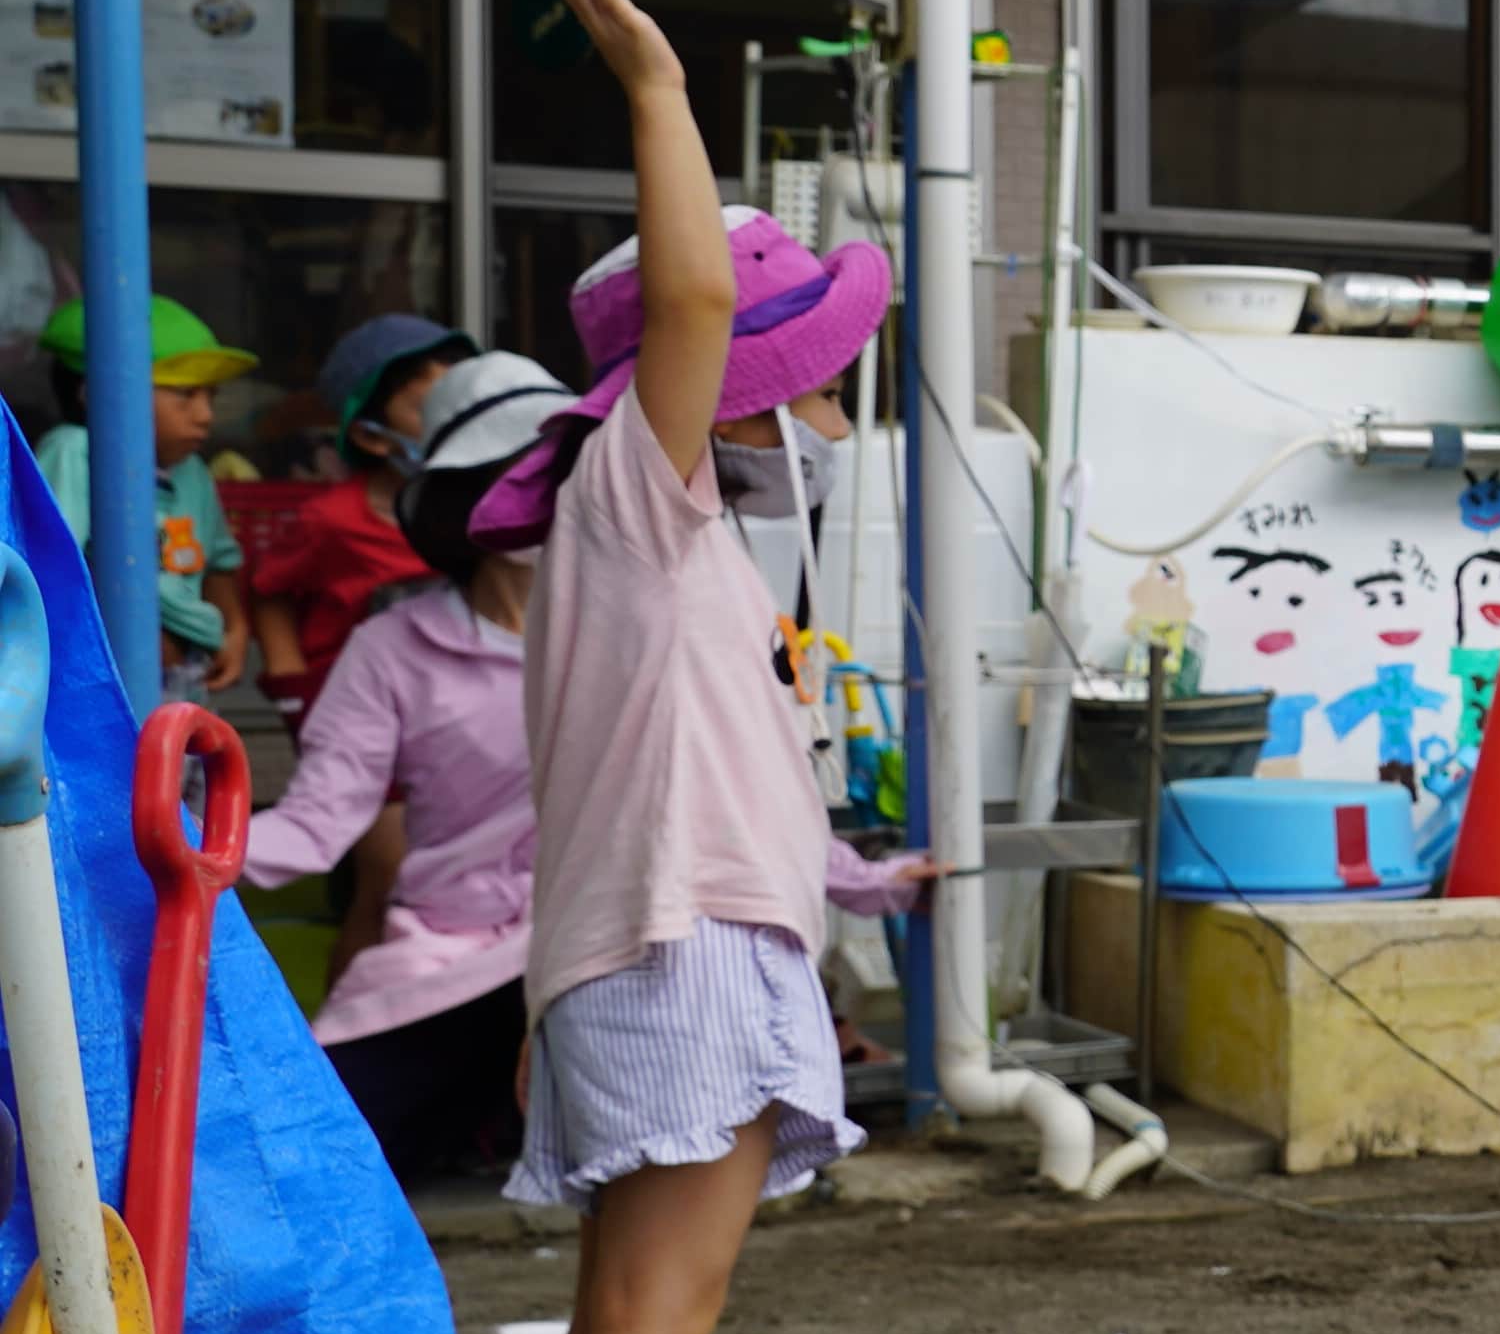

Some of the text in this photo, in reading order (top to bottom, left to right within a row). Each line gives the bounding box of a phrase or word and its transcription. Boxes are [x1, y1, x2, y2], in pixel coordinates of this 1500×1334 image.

[1240, 502, 1315, 536] すみれ
[1390, 539, 1437, 592] そうた
